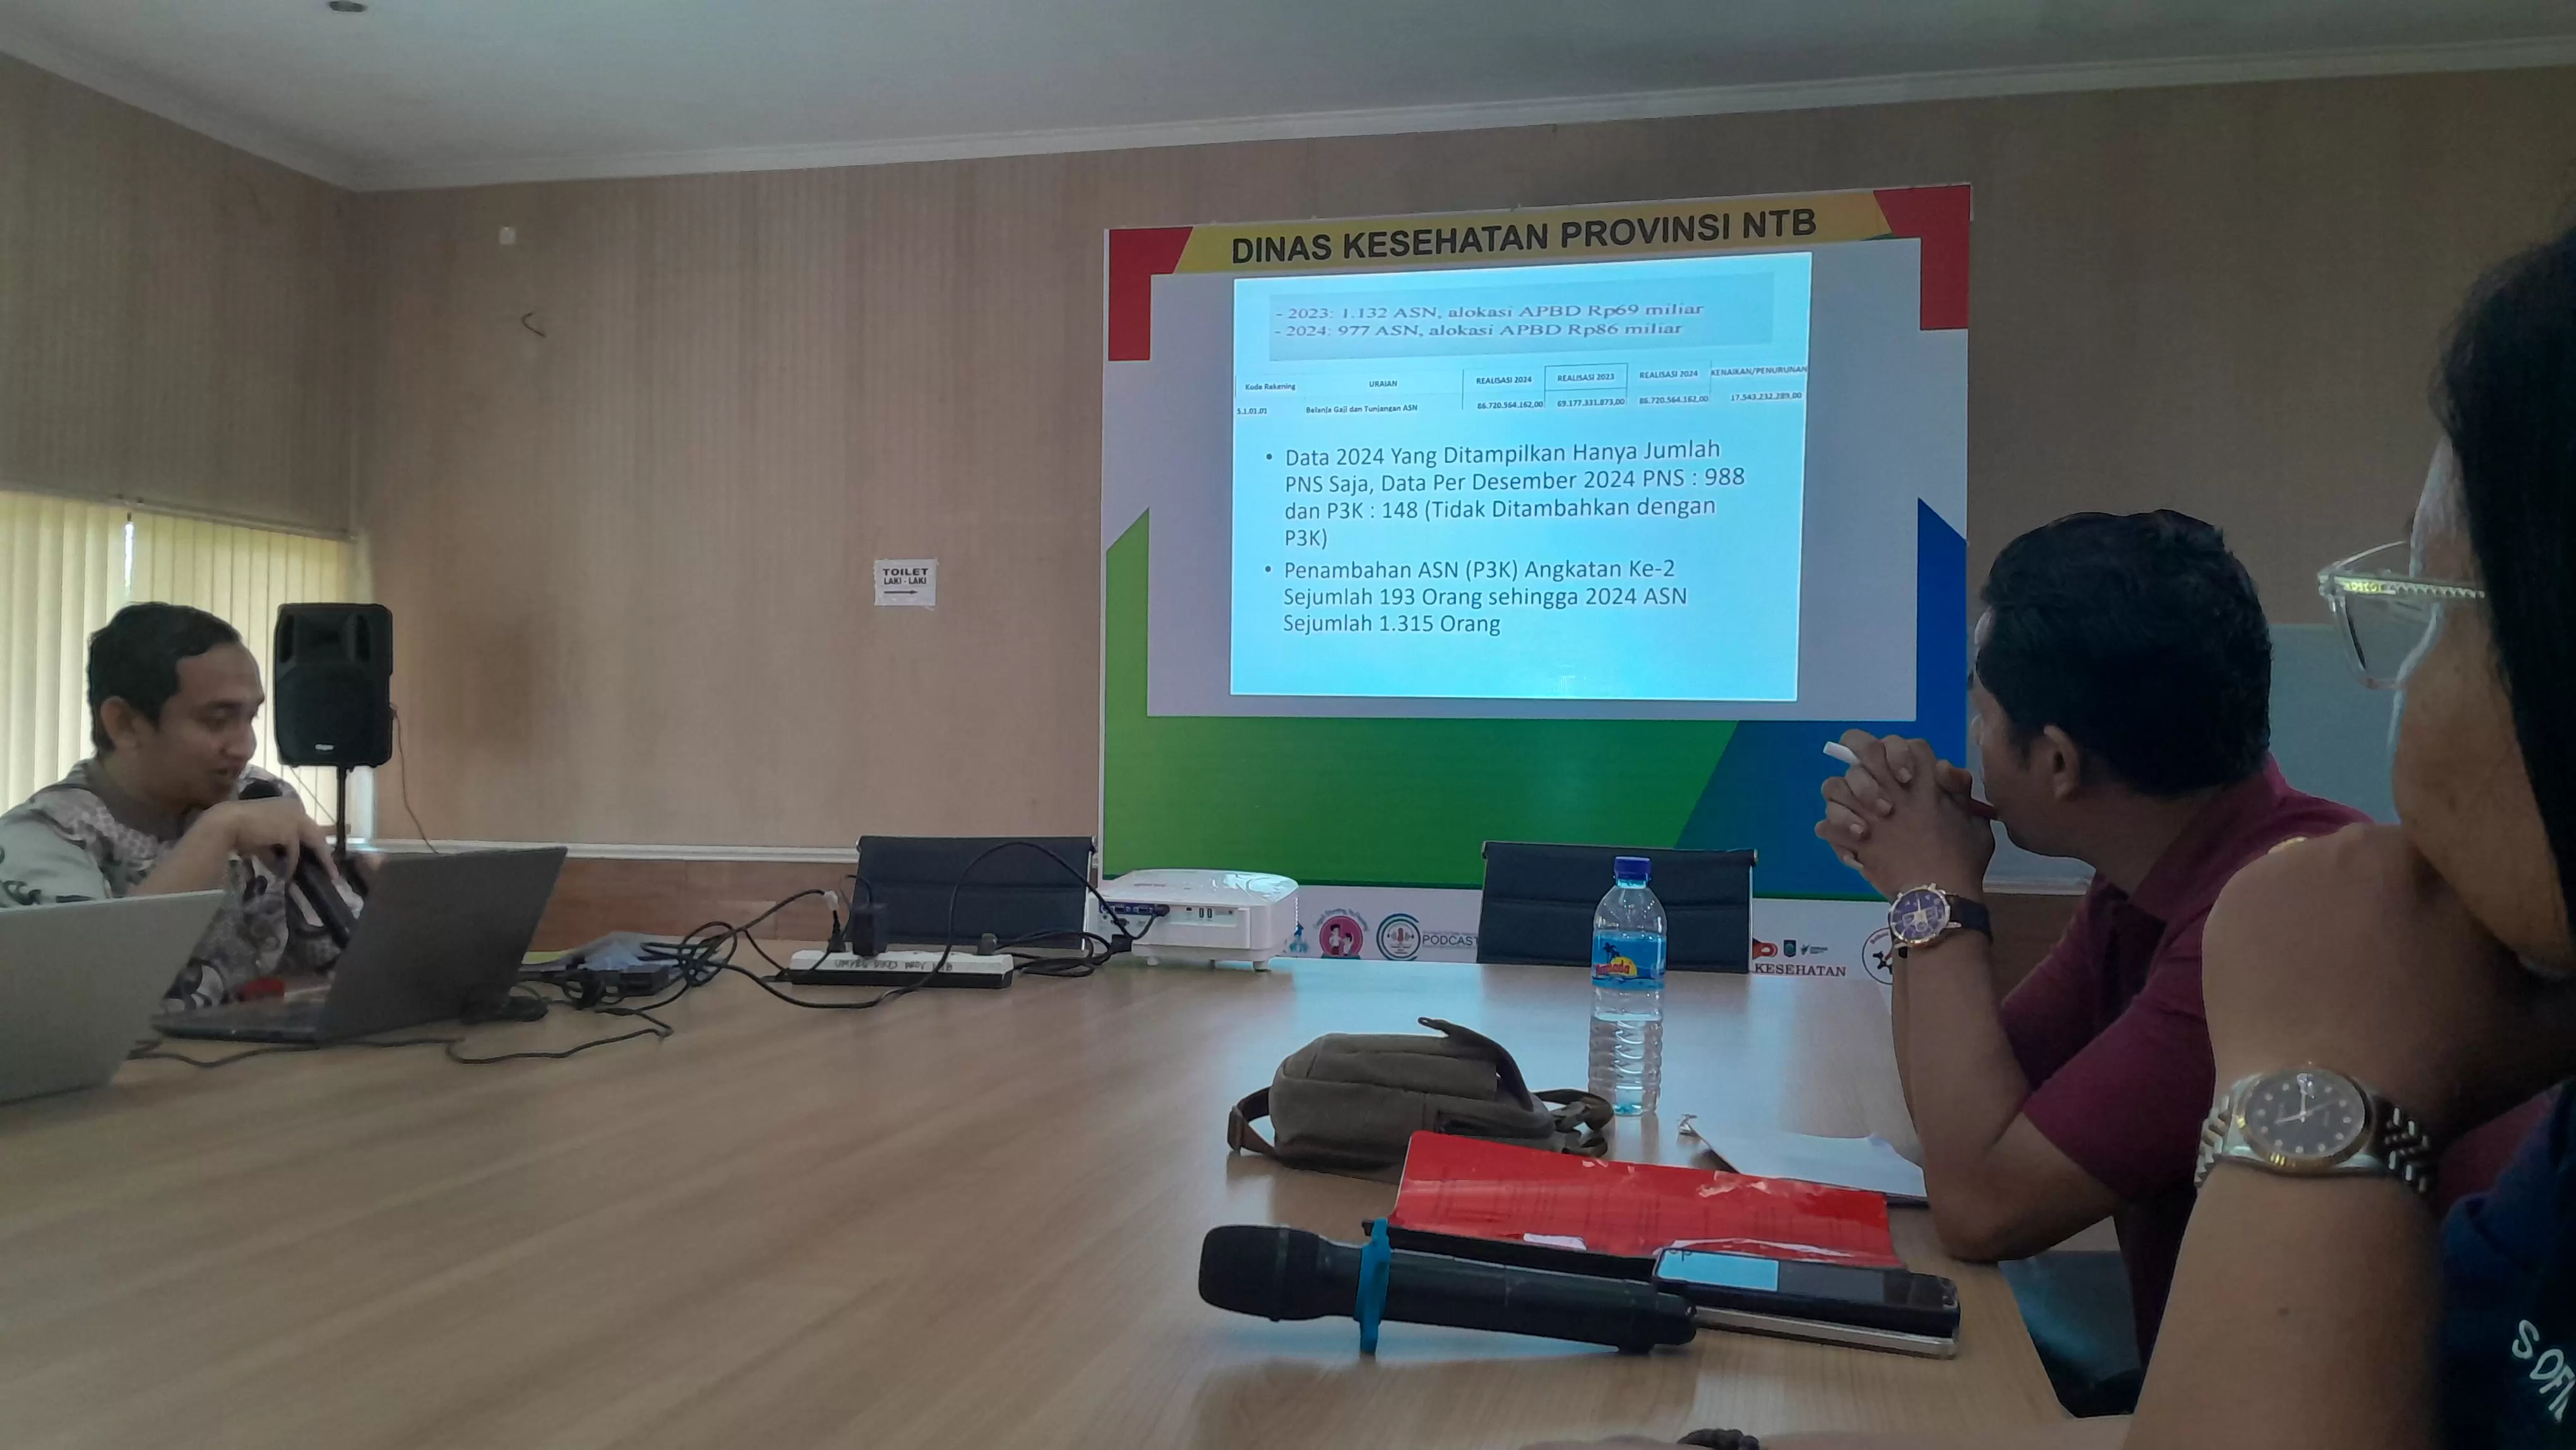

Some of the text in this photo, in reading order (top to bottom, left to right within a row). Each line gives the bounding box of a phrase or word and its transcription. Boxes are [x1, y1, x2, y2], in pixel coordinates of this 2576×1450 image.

[1232, 208, 1816, 264] DINAS KESEHATAN PROVINSI NTB
[1289, 308, 1333, 319] 2023:
[1343, 308, 1387, 318] 1.132
[1393, 307, 1442, 319] ASN,
[1448, 306, 1513, 318] alokasi
[1518, 306, 1582, 317] APBD
[1589, 304, 1638, 319] Rp69
[1645, 304, 1703, 315] miliar
[1286, 326, 1330, 336] 2024:
[1339, 326, 1369, 335] 977
[1375, 325, 1423, 337] ASN,
[1429, 324, 1493, 335] alokasi
[1500, 324, 1561, 335] APBD
[1568, 323, 1618, 338] Rp86
[1625, 322, 1683, 334] miliar
[1286, 440, 1720, 469] Data 2024 Yang Ditampilkan Hanya Jumlah
[1285, 467, 1745, 498] PNS Saja, Data Per Desember 2024 PNS : 988
[1285, 496, 1715, 522] dan P3K : 148 (Tidak Ditambahkan dengan
[1285, 527, 1327, 550] P3K)
[1284, 558, 1674, 582] Penambahan ASN (P3K) Angkatan Ke-2
[1284, 586, 1686, 611] Sejumlah 193 Orang sehingga 2024 ASN
[1283, 613, 1500, 637] Sejumlah 1.315 Orang
[1755, 964, 1846, 976] KESEHATAN
